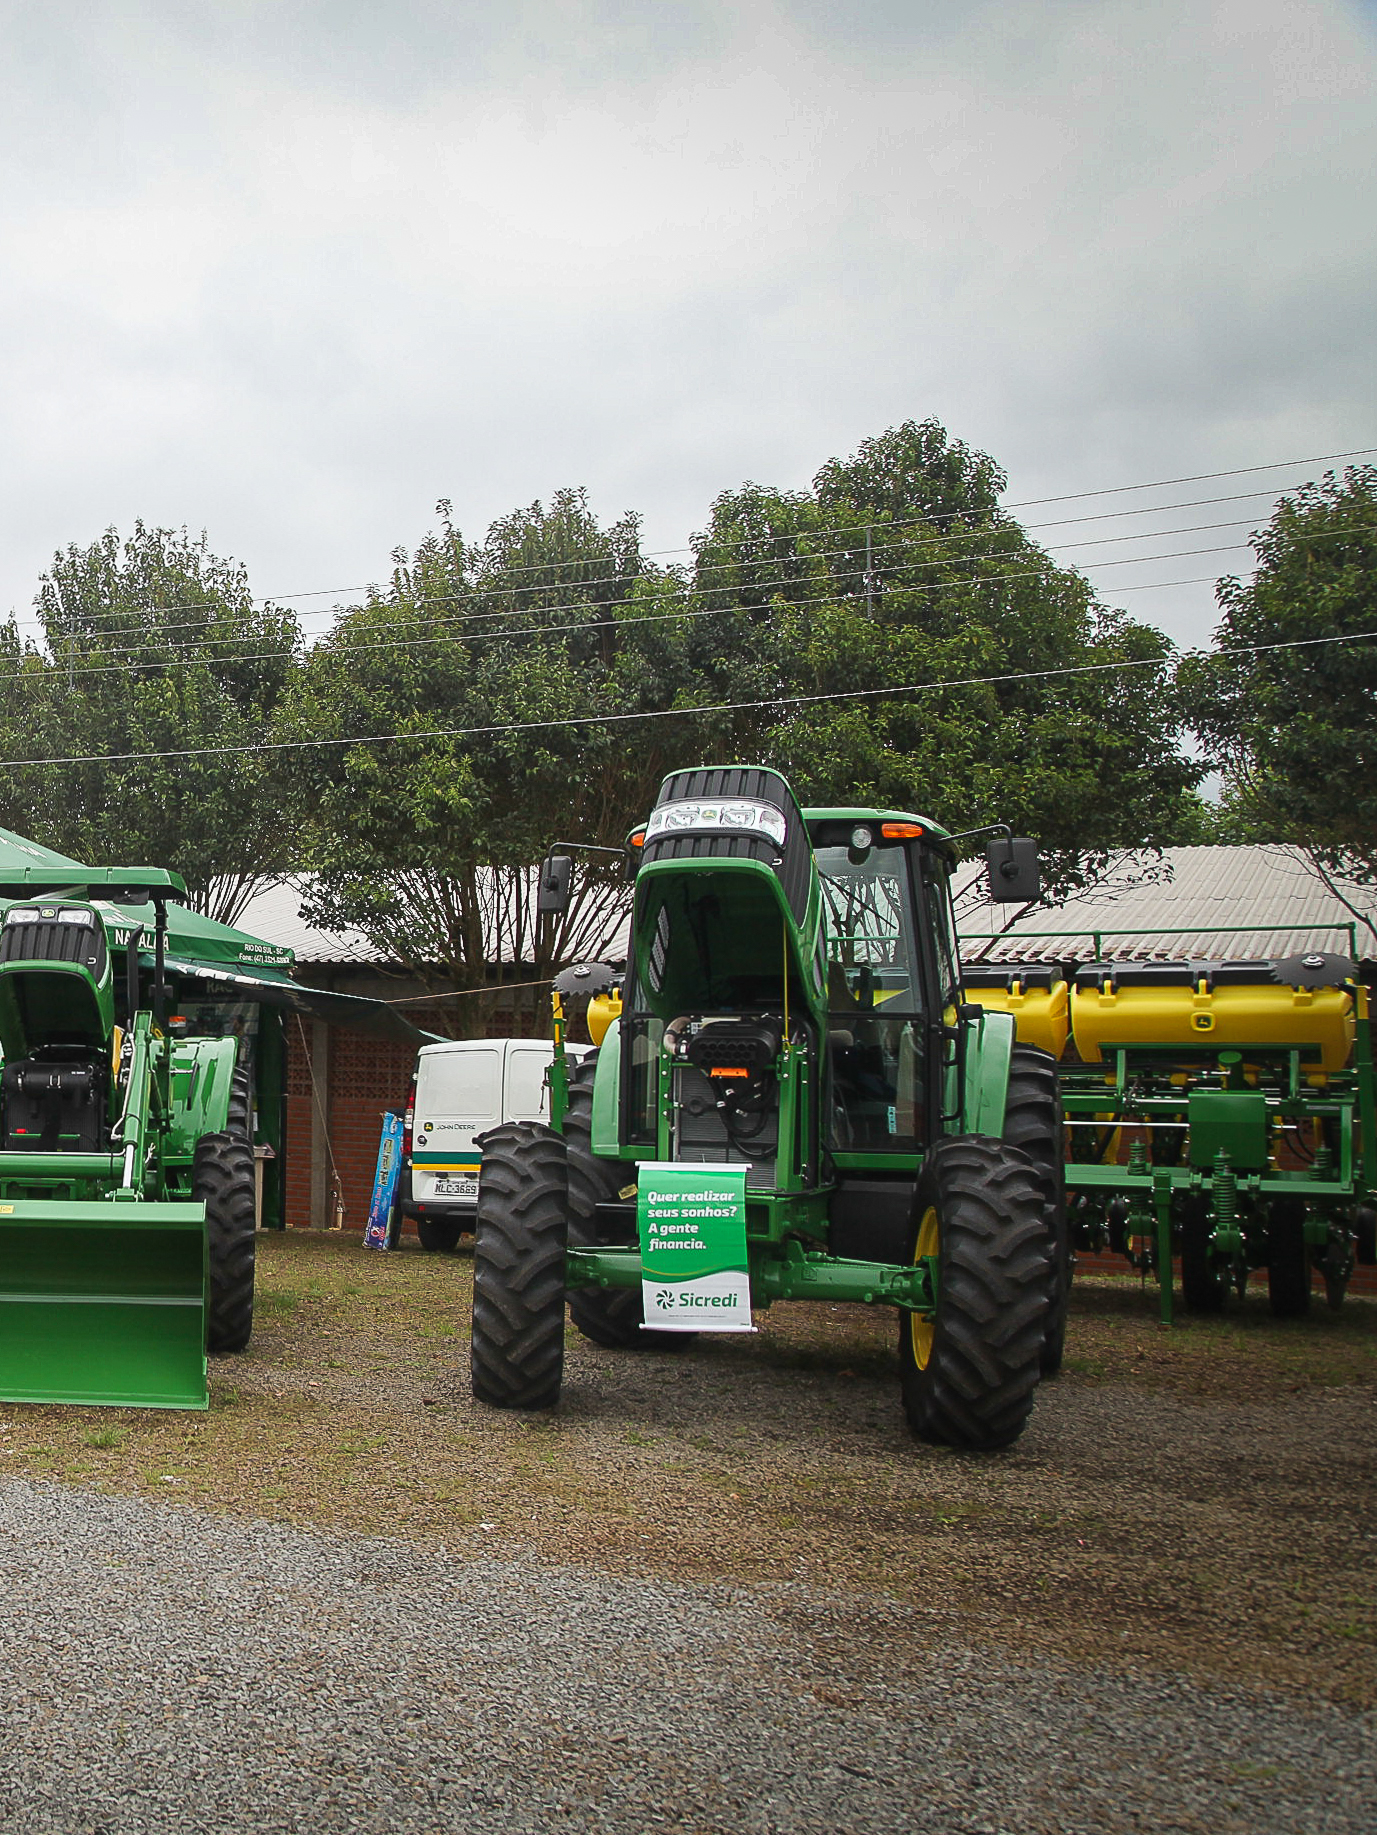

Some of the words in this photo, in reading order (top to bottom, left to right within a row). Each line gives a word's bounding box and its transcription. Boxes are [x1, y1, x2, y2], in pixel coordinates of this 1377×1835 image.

[115, 929, 170, 951] NAALA
[254, 944, 263, 953] DO
[647, 1191, 679, 1205] Quer
[681, 1190, 736, 1202] realizar
[647, 1208, 679, 1218] seus
[680, 1206, 738, 1218] sonhos?
[647, 1222, 659, 1234] A
[659, 1223, 699, 1237] gente
[648, 1237, 707, 1252] financia.
[679, 1292, 738, 1308] Sicredi
